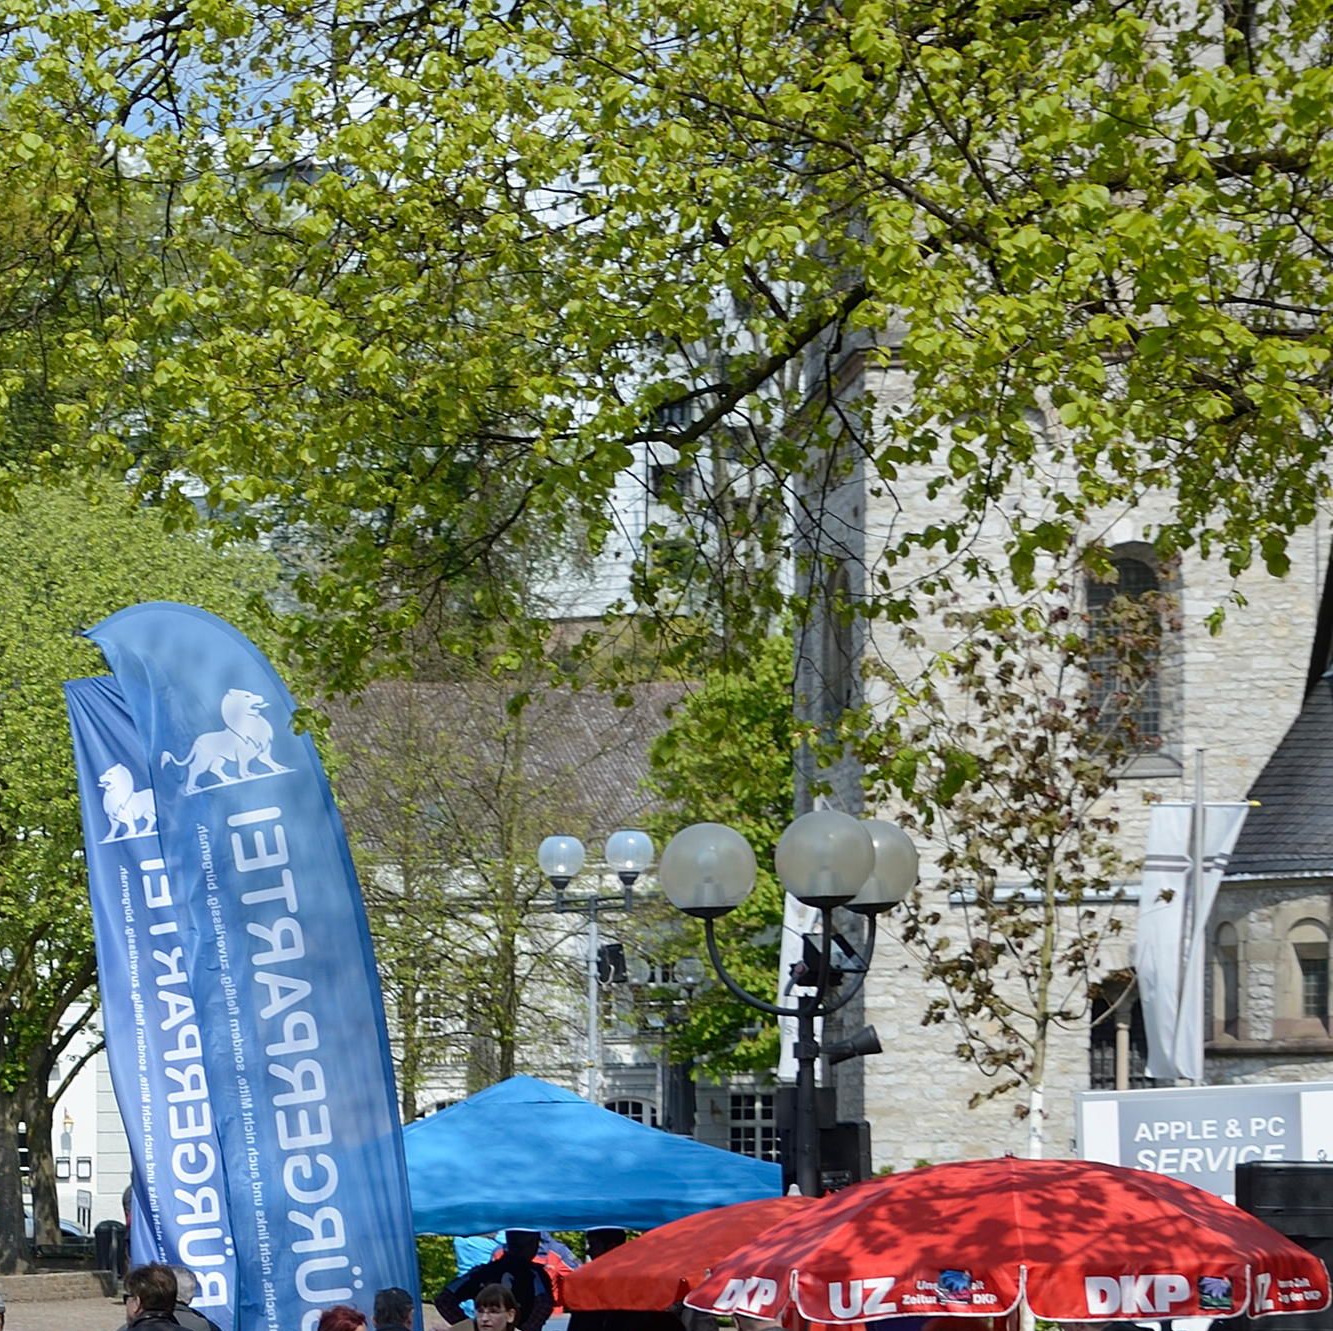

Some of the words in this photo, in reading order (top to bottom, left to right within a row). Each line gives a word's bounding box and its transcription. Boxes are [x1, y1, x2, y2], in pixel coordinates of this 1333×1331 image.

[1134, 1119, 1218, 1142] APPLE
[1224, 1117, 1243, 1139] &
[1250, 1116, 1286, 1138] PC
[1134, 1144, 1286, 1174] SERVICE
[714, 1276, 778, 1313] DKP
[829, 1277, 897, 1319] UZ
[1085, 1274, 1191, 1316] DKP
